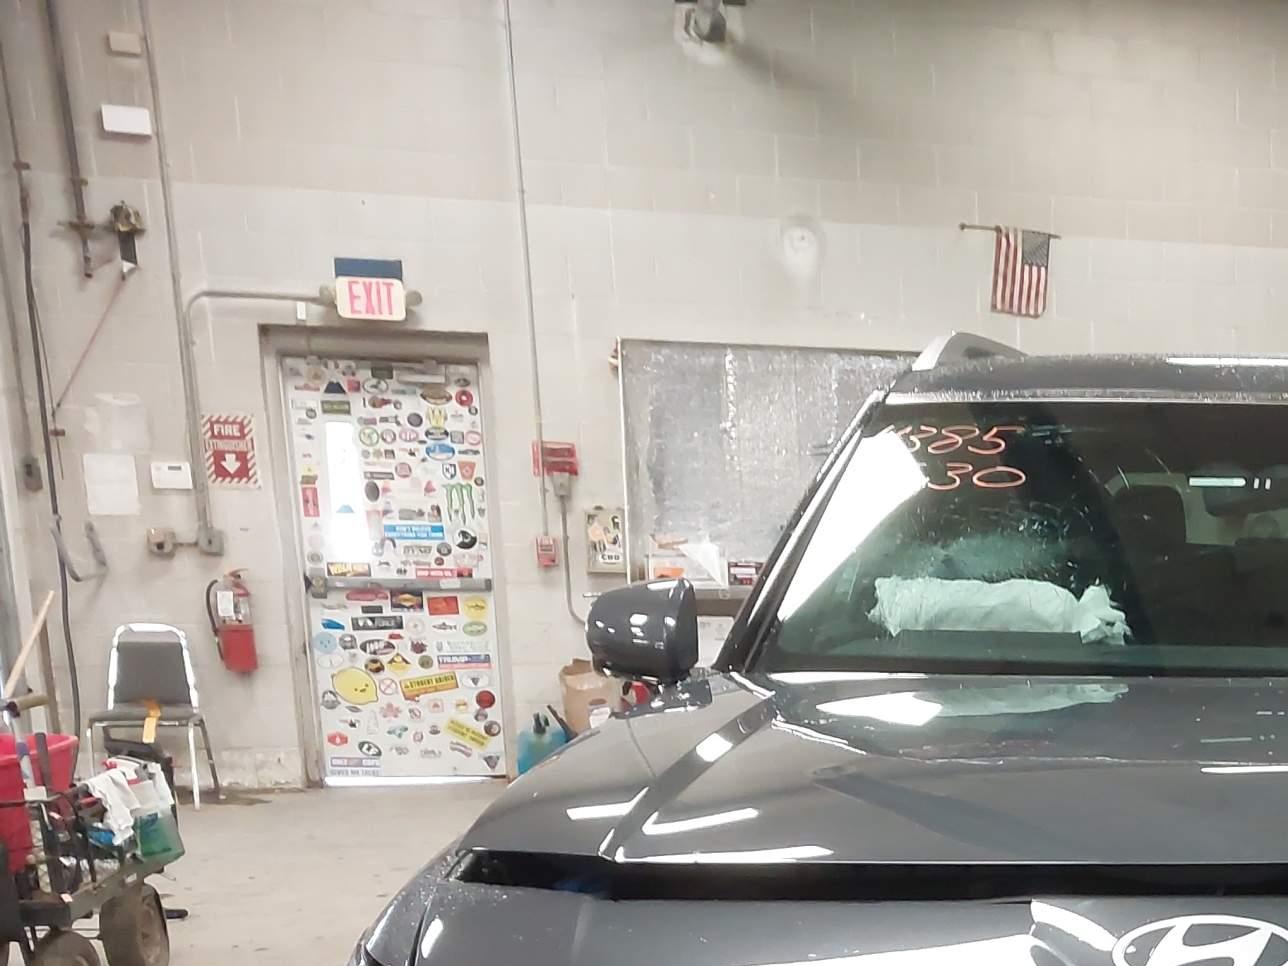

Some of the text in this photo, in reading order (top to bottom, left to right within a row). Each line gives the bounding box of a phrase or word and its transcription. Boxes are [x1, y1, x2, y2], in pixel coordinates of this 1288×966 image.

[347, 280, 395, 316] EXIT
[213, 423, 241, 437] FIRE
[897, 423, 1026, 455] 385
